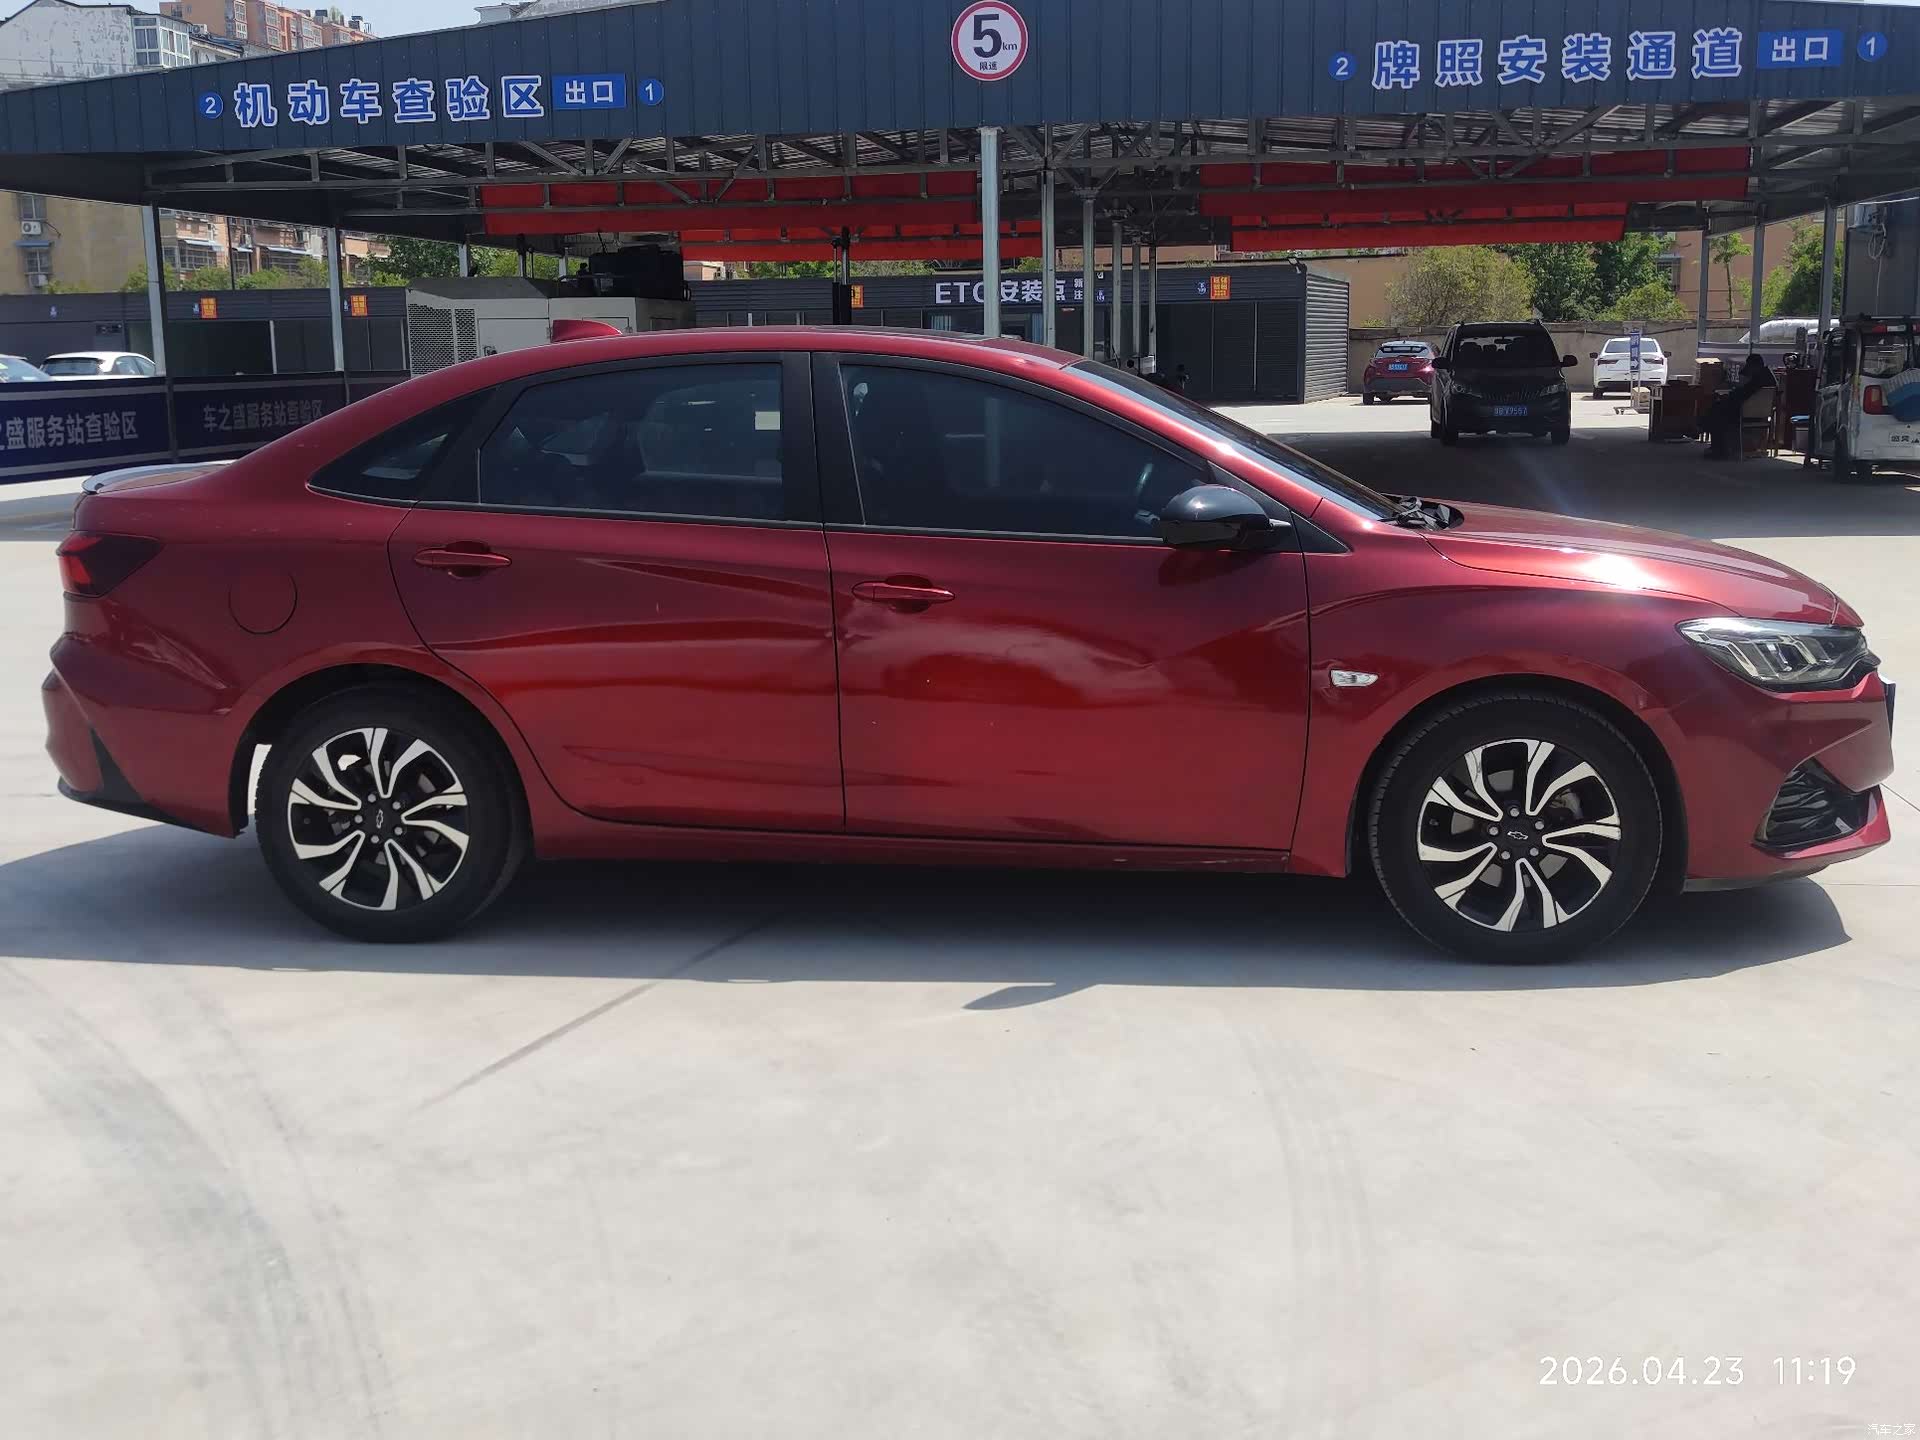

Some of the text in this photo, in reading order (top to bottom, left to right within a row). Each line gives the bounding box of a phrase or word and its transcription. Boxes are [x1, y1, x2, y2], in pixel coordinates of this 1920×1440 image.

[973, 14, 1018, 58] 5 km
[1335, 58, 1349, 75] 2
[1372, 27, 1743, 89] 牌照安装通道
[1771, 36, 1829, 62] 出口
[979, 61, 998, 71] 限速
[204, 97, 218, 115] 2
[234, 75, 544, 128] 机动车查验区
[564, 80, 614, 104] 出口
[203, 400, 323, 432] 车之盛服务站查验区
